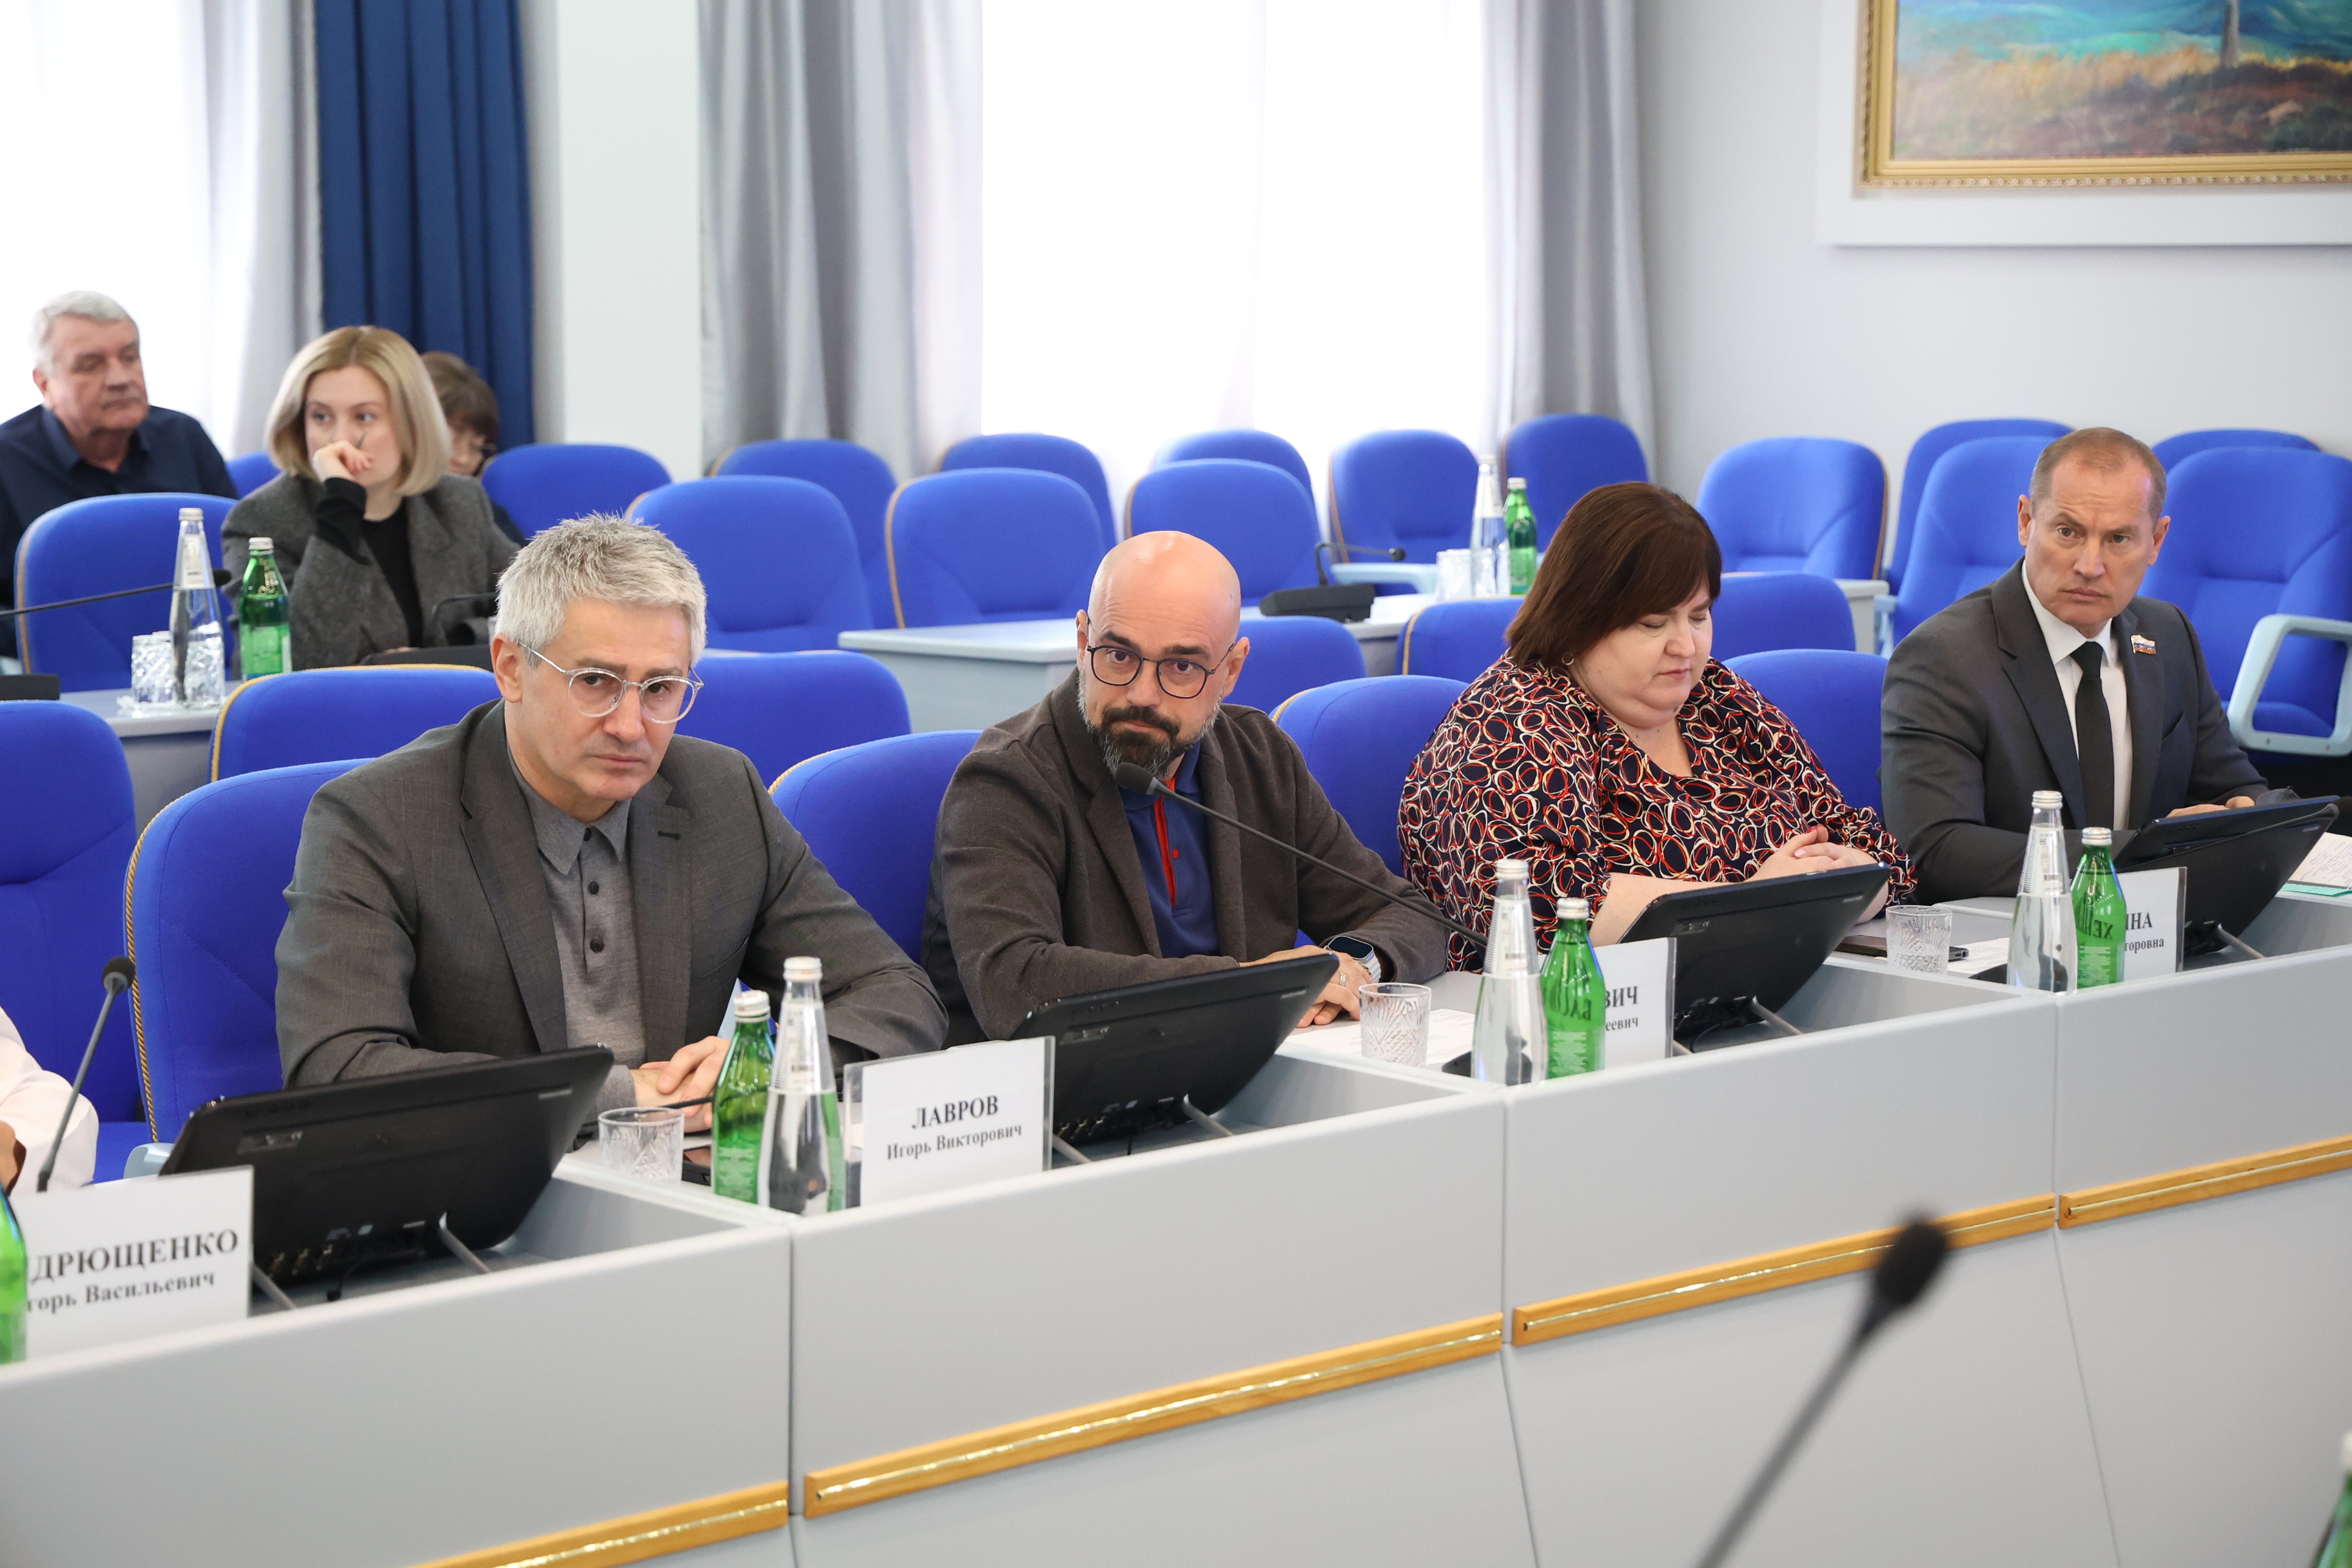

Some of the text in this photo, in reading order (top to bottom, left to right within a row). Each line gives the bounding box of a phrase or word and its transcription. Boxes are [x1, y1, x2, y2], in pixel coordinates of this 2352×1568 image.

[1605, 1017, 1639, 1032] еевич
[912, 1095, 999, 1129] ЛАВРОВ
[887, 1124, 1023, 1160] Игорь Викторович
[31, 1228, 238, 1285] ДРЮЩЕНКО
[27, 1272, 215, 1315] горь Васильевич
